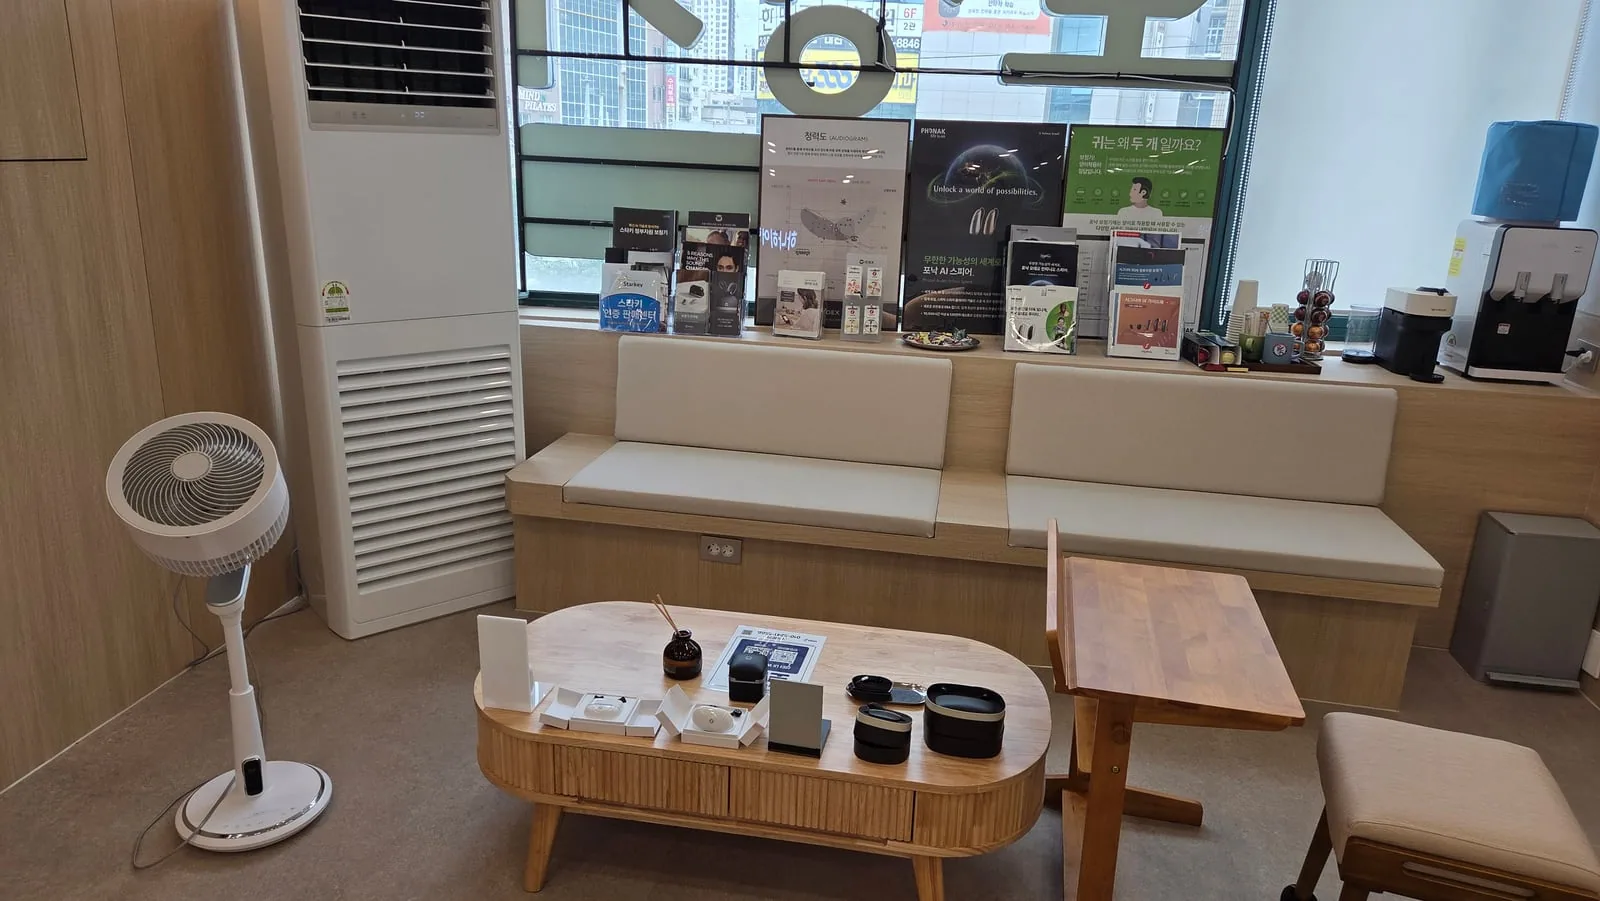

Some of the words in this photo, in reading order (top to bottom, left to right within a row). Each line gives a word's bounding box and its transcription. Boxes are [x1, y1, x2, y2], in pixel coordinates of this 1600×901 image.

[903, 7, 917, 19] 6F
[519, 89, 541, 101] MIND
[524, 101, 557, 112] PILATES
[804, 131, 827, 141] 청력도
[920, 127, 946, 135] PHONAK
[1092, 135, 1116, 150] 귀는
[1117, 136, 1130, 150] 왜
[1131, 137, 1144, 150] 두
[1146, 137, 1158, 151] 개
[1160, 137, 1202, 152] 일까요?
[933, 185, 957, 193] Unlock
[965, 186, 985, 194] world
[996, 187, 1038, 196] possibilities.
[923, 255, 946, 265] 무한한
[947, 256, 978, 266] 가능성의
[922, 266, 938, 275] 포낙
[939, 267, 949, 275] AI
[618, 299, 642, 308] 스타키
[604, 309, 620, 319] 인증
